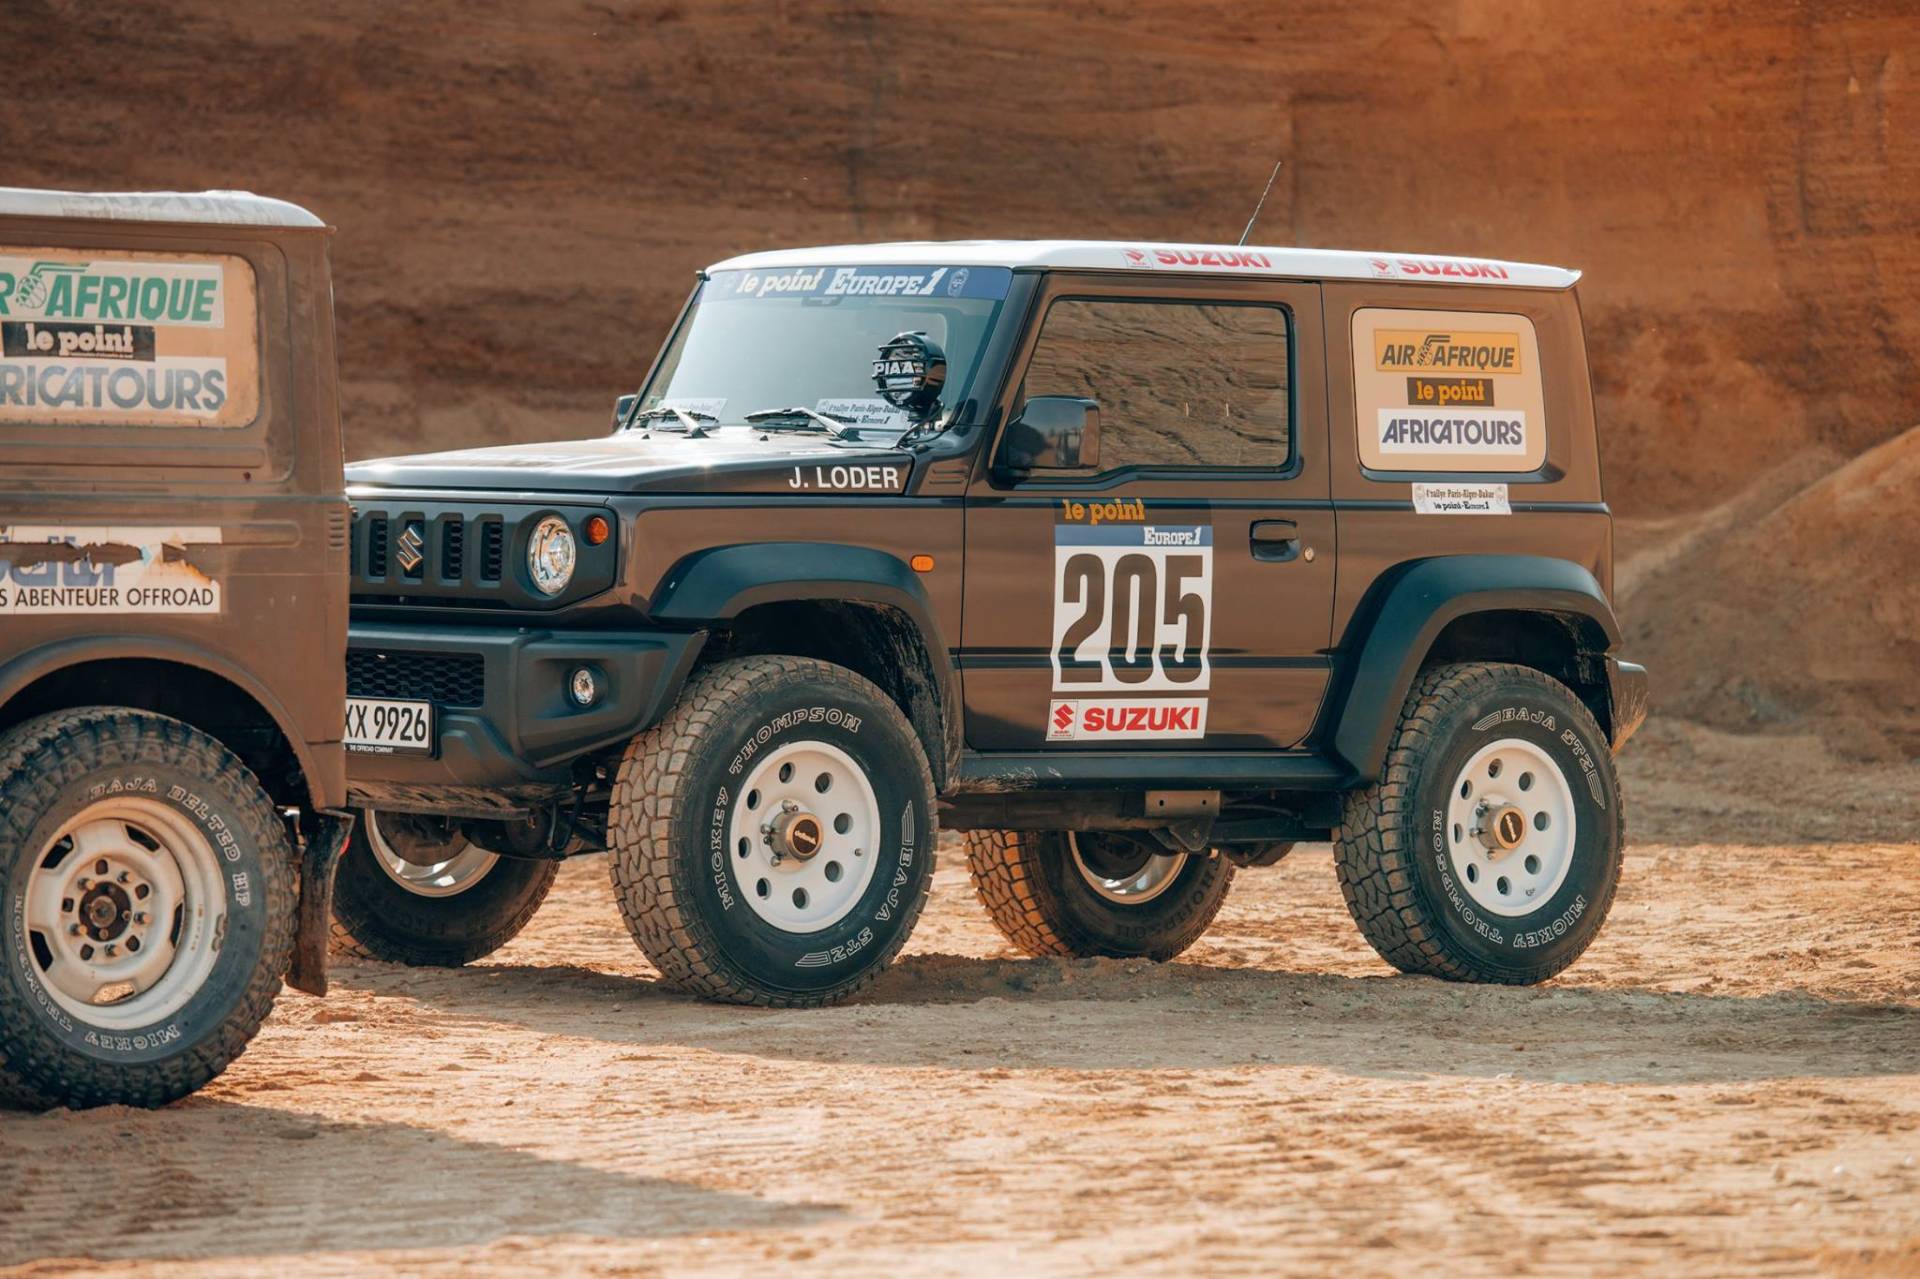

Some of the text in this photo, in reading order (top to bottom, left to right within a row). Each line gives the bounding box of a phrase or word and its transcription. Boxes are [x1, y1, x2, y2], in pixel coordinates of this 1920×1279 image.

[1154, 249, 1272, 268] SUZUKI
[1397, 259, 1509, 280] SUZUKI
[735, 273, 754, 294] le
[756, 268, 825, 297] point
[45, 274, 218, 322] AFRIQUE
[25, 323, 134, 357] le point
[1381, 344, 1516, 370] AIR AFRIQUE
[0, 364, 226, 411] RICATOURS
[1416, 380, 1486, 406] le point
[1382, 418, 1523, 446] AFRICATOURS
[788, 466, 899, 489] J. LODER
[1062, 498, 1146, 525] le point
[15, 587, 119, 607] ABENTEUER
[126, 587, 214, 607] OFFROAD
[1058, 553, 1205, 684] 205
[374, 705, 427, 742] 9926
[1083, 706, 1200, 732] SUZUKI
[1501, 707, 1596, 773] BAJA STZ
[711, 707, 862, 911] MICKEY THOMPSON
[90, 777, 250, 907] BAJA BELTED HP
[1432, 809, 1588, 948] MICKEY THOMPSON
[831, 848, 914, 963] BAJA STZ
[84, 1024, 181, 1051] MICKEY
